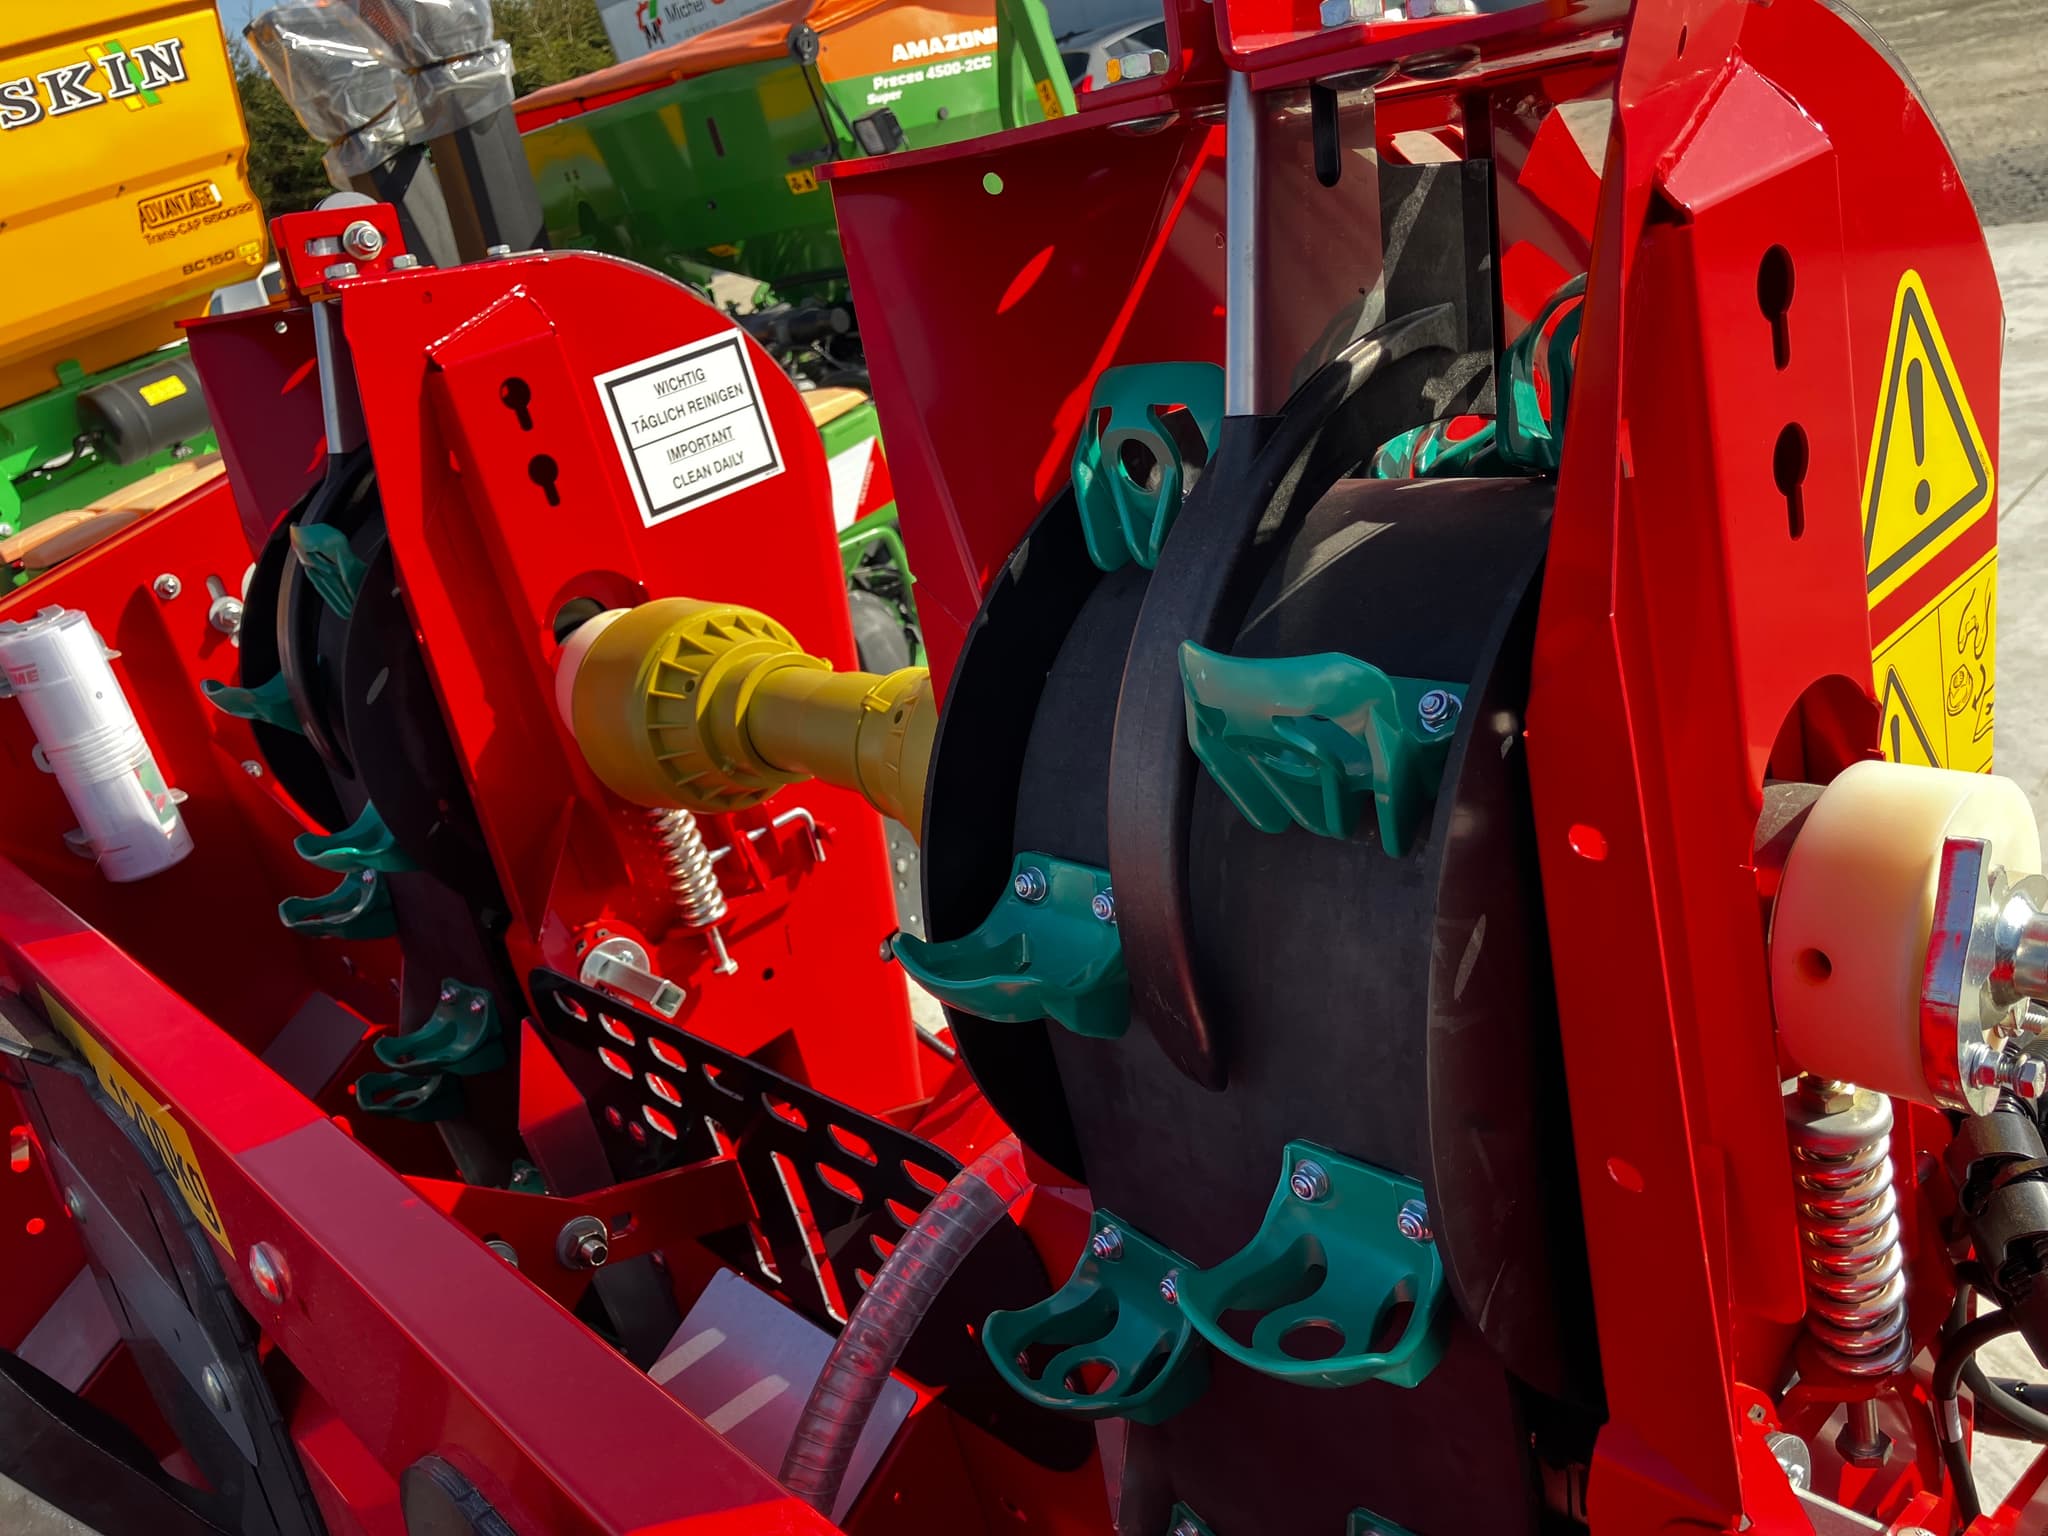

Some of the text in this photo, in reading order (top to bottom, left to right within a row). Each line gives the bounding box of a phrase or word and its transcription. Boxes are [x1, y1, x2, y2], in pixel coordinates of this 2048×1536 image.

[0, 37, 187, 131] SKIN
[872, 55, 992, 91] Precea 4500-2CC
[866, 90, 903, 105] Super
[138, 184, 218, 233] ADVANTAGE
[653, 367, 706, 396] WICHTIG
[631, 383, 744, 434] TÄGLICH REINIGEN
[666, 426, 734, 462] IMPORTANT
[672, 450, 746, 490] CLEAN DAILY
